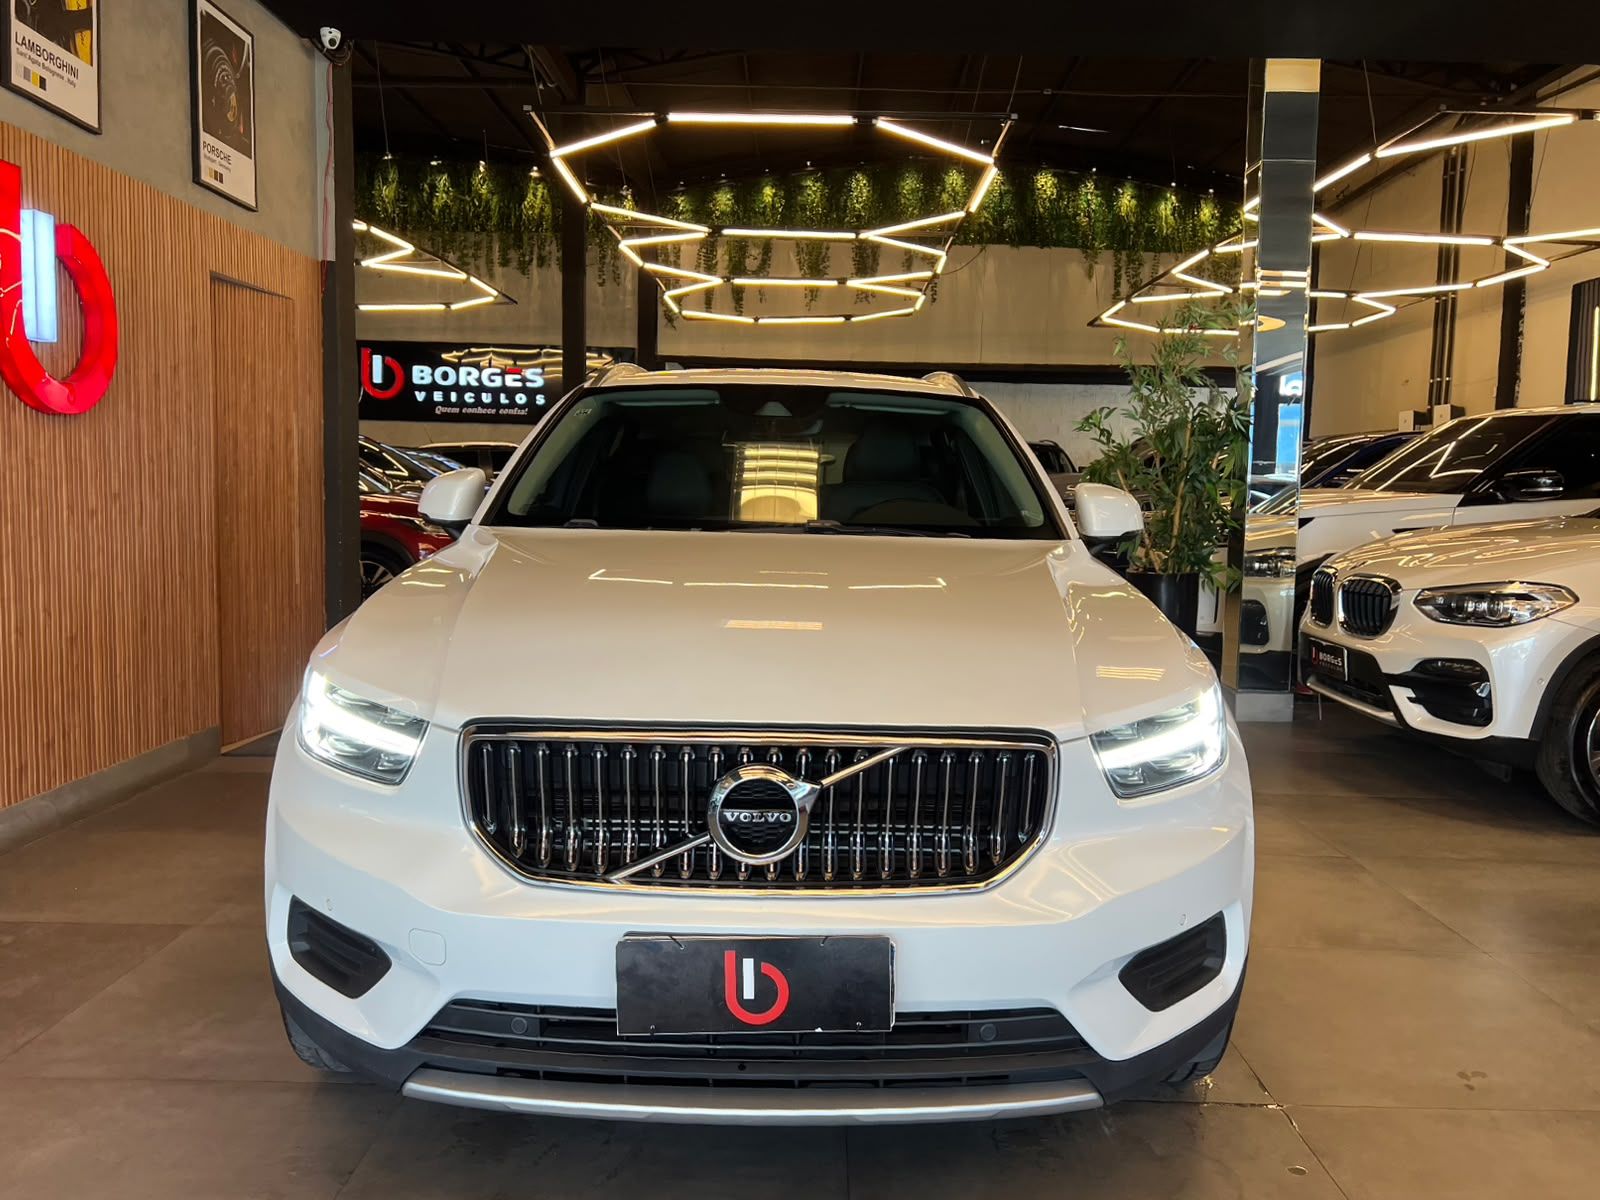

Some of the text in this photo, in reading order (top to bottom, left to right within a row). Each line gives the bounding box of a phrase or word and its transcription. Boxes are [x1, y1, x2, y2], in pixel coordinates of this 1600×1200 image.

[15, 31, 79, 80] LAMBORGHINI
[202, 141, 231, 165] PORSCHE
[412, 365, 545, 388] BORGES
[414, 390, 546, 405] VEICULOS
[434, 405, 460, 415] Quem
[462, 406, 496, 414] conhece
[723, 812, 792, 823] VOLVO
